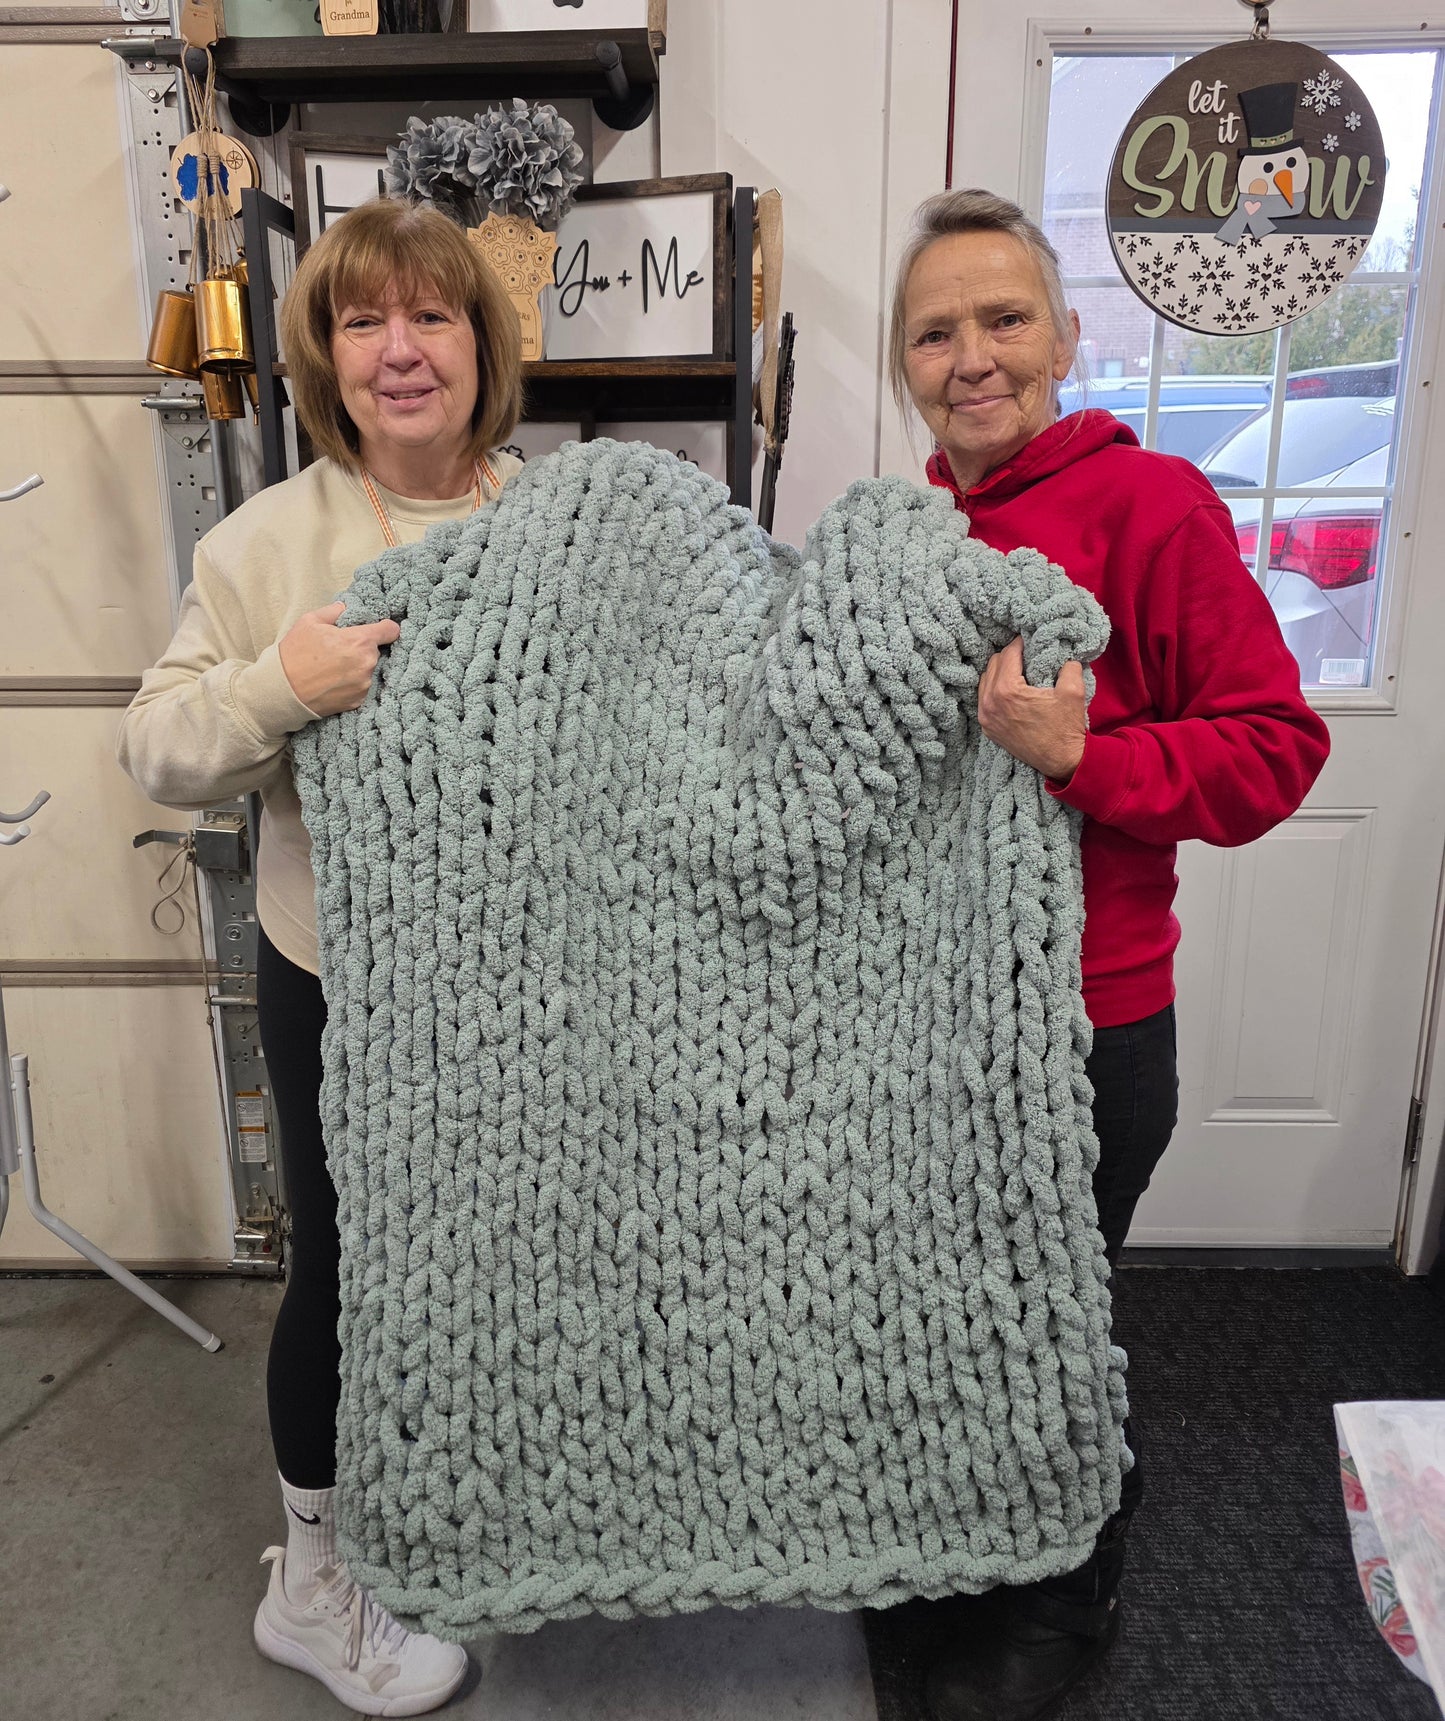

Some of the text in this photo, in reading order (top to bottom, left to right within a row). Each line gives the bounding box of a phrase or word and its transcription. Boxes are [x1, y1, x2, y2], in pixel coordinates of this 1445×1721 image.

[330, 10, 370, 20] Grandma
[1187, 79, 1229, 115] let
[1217, 112, 1241, 145] it
[641, 236, 705, 315] Me
